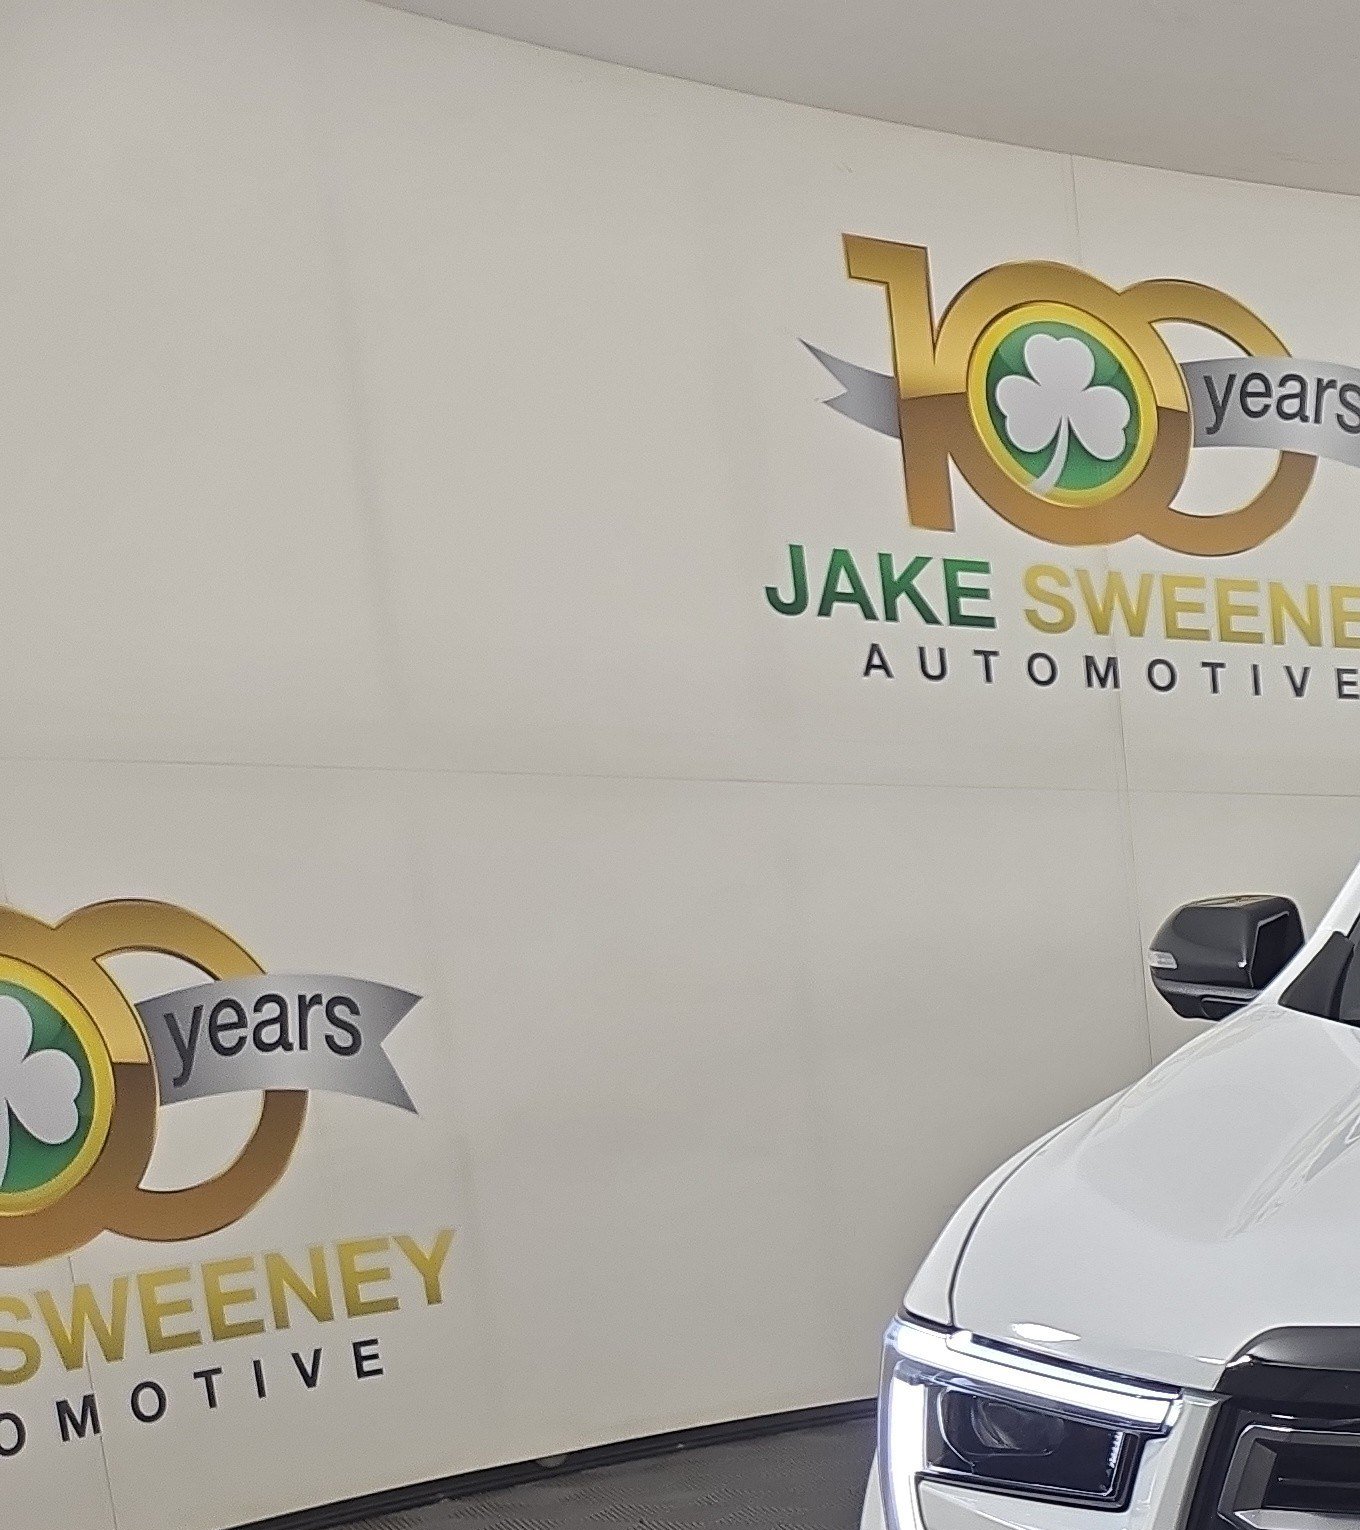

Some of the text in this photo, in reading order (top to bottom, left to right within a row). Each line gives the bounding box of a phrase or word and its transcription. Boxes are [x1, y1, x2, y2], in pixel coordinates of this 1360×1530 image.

[842, 233, 1319, 556] 100
[765, 543, 997, 628] JAKE
[863, 642, 1360, 699] AUTOMOTIVE
[163, 992, 362, 1087] years
[0, 1338, 384, 1457] OMOTIVE
